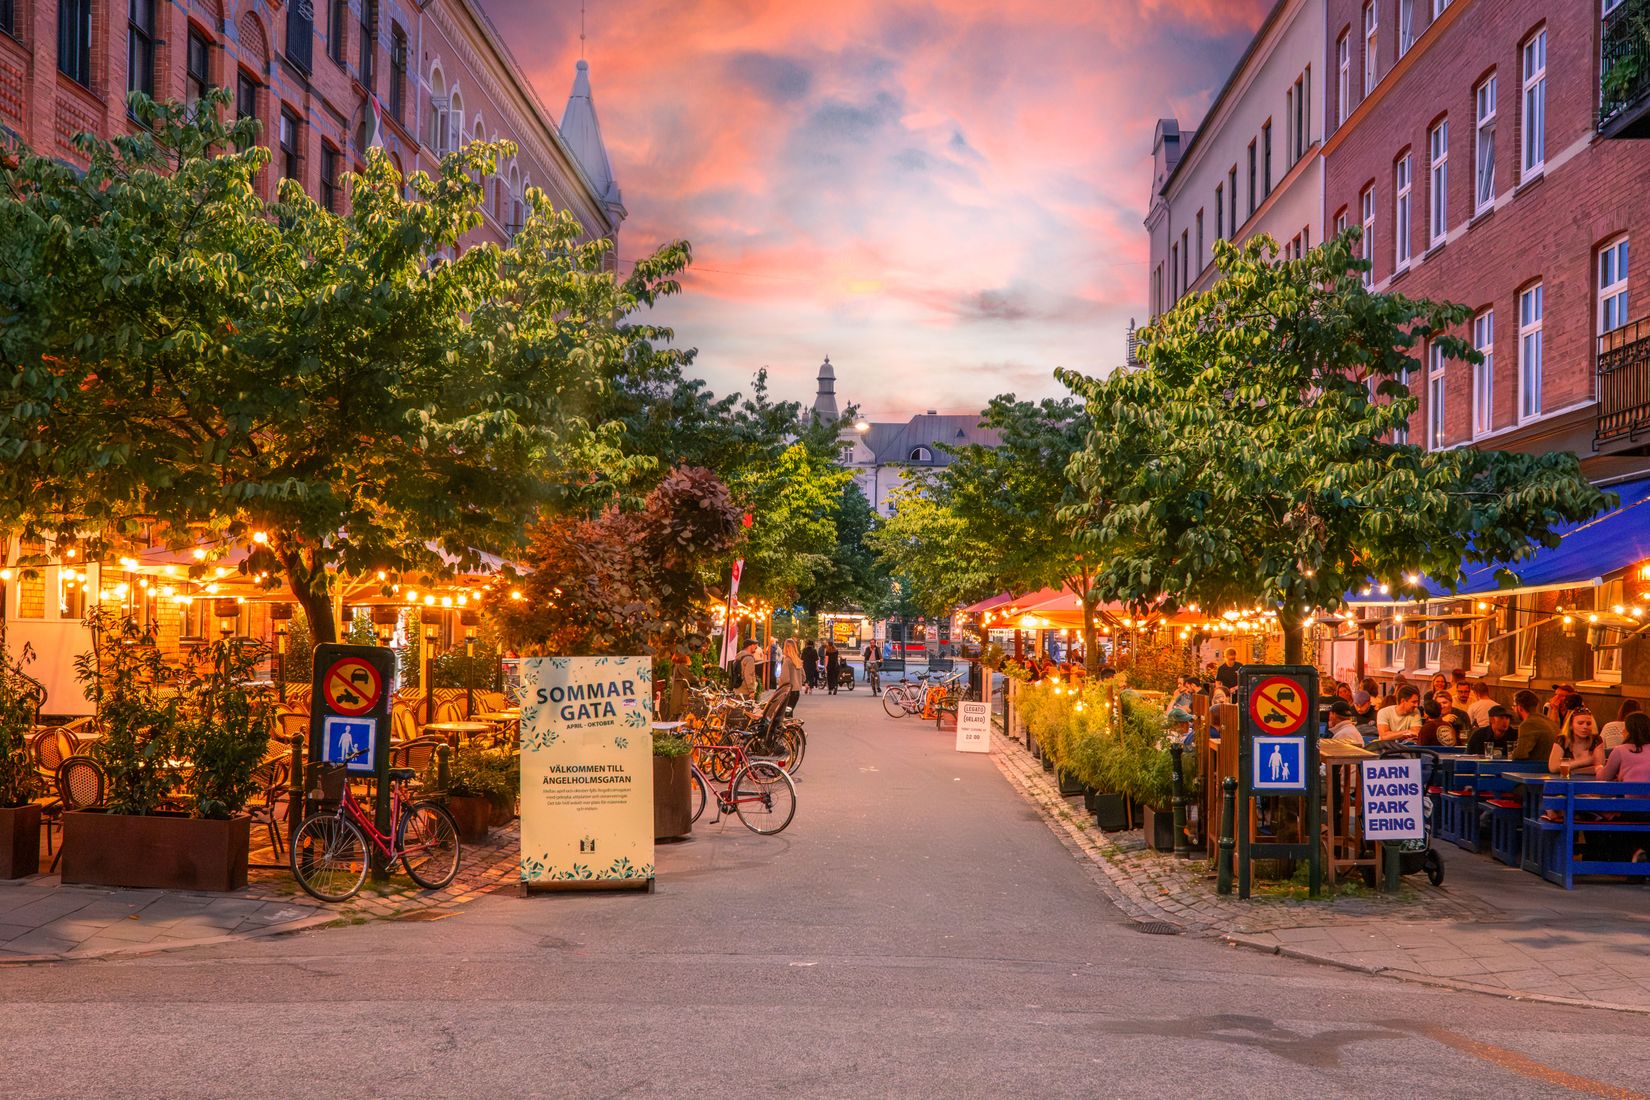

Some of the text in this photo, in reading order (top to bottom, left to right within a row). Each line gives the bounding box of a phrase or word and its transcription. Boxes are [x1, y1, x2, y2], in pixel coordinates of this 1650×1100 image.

[537, 679, 635, 705] SOMMAR
[560, 701, 617, 722] GATA
[566, 722, 584, 730] APRIL
[587, 720, 615, 728] OKTOBER
[549, 763, 625, 774] VÄLKOMMEN TILL
[1367, 766, 1409, 779] BARN
[543, 774, 632, 785] ÄNGELHOLMSGATAN
[1366, 783, 1419, 796] VAGNS
[1368, 801, 1410, 814] PARK
[1368, 818, 1416, 831] ERING
